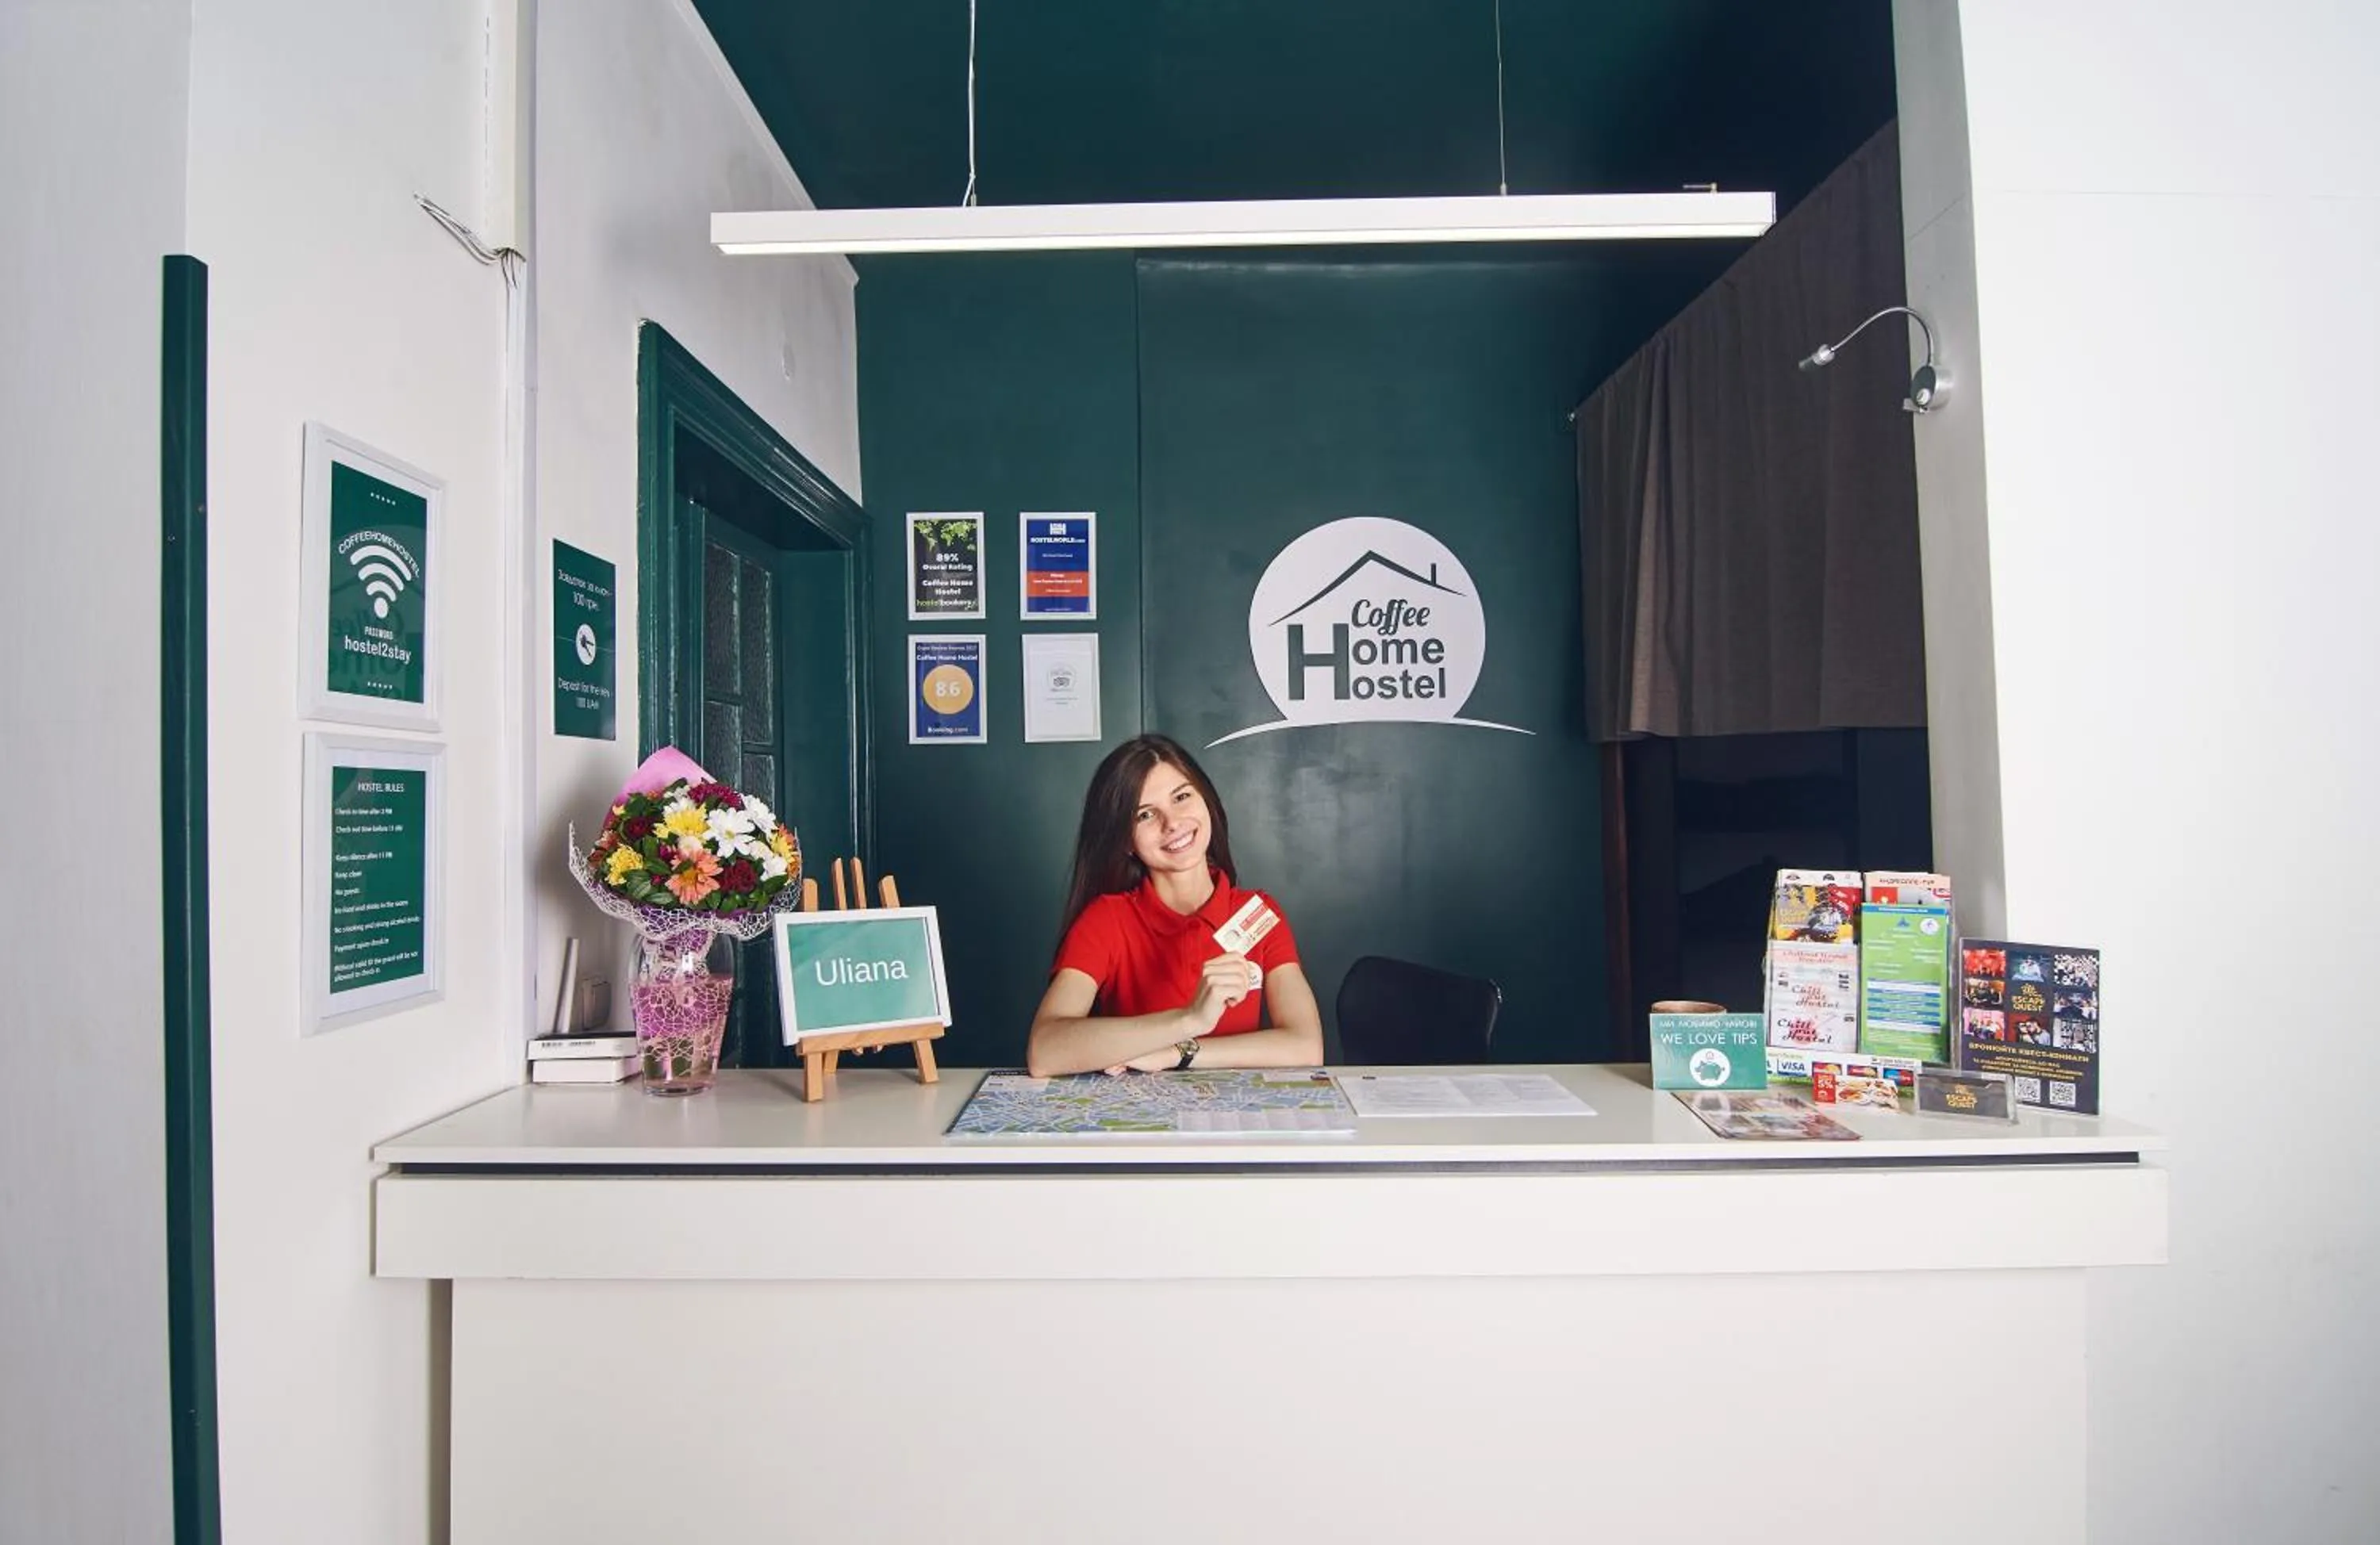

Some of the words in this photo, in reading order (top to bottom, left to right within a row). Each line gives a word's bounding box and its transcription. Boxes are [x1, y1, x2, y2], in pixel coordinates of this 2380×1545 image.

[936, 553, 959, 562] 89%
[1351, 599, 1430, 635] Coffee
[344, 635, 412, 665] hostel2stay
[358, 782, 383, 792] HOSTEL
[385, 783, 405, 792] RULES
[815, 957, 909, 986] Uliana
[1660, 1033, 1683, 1045] WE
[1688, 1032, 1726, 1045] LOVE
[1732, 1033, 1757, 1045] TIPS
[1781, 1061, 1805, 1072] VISA
